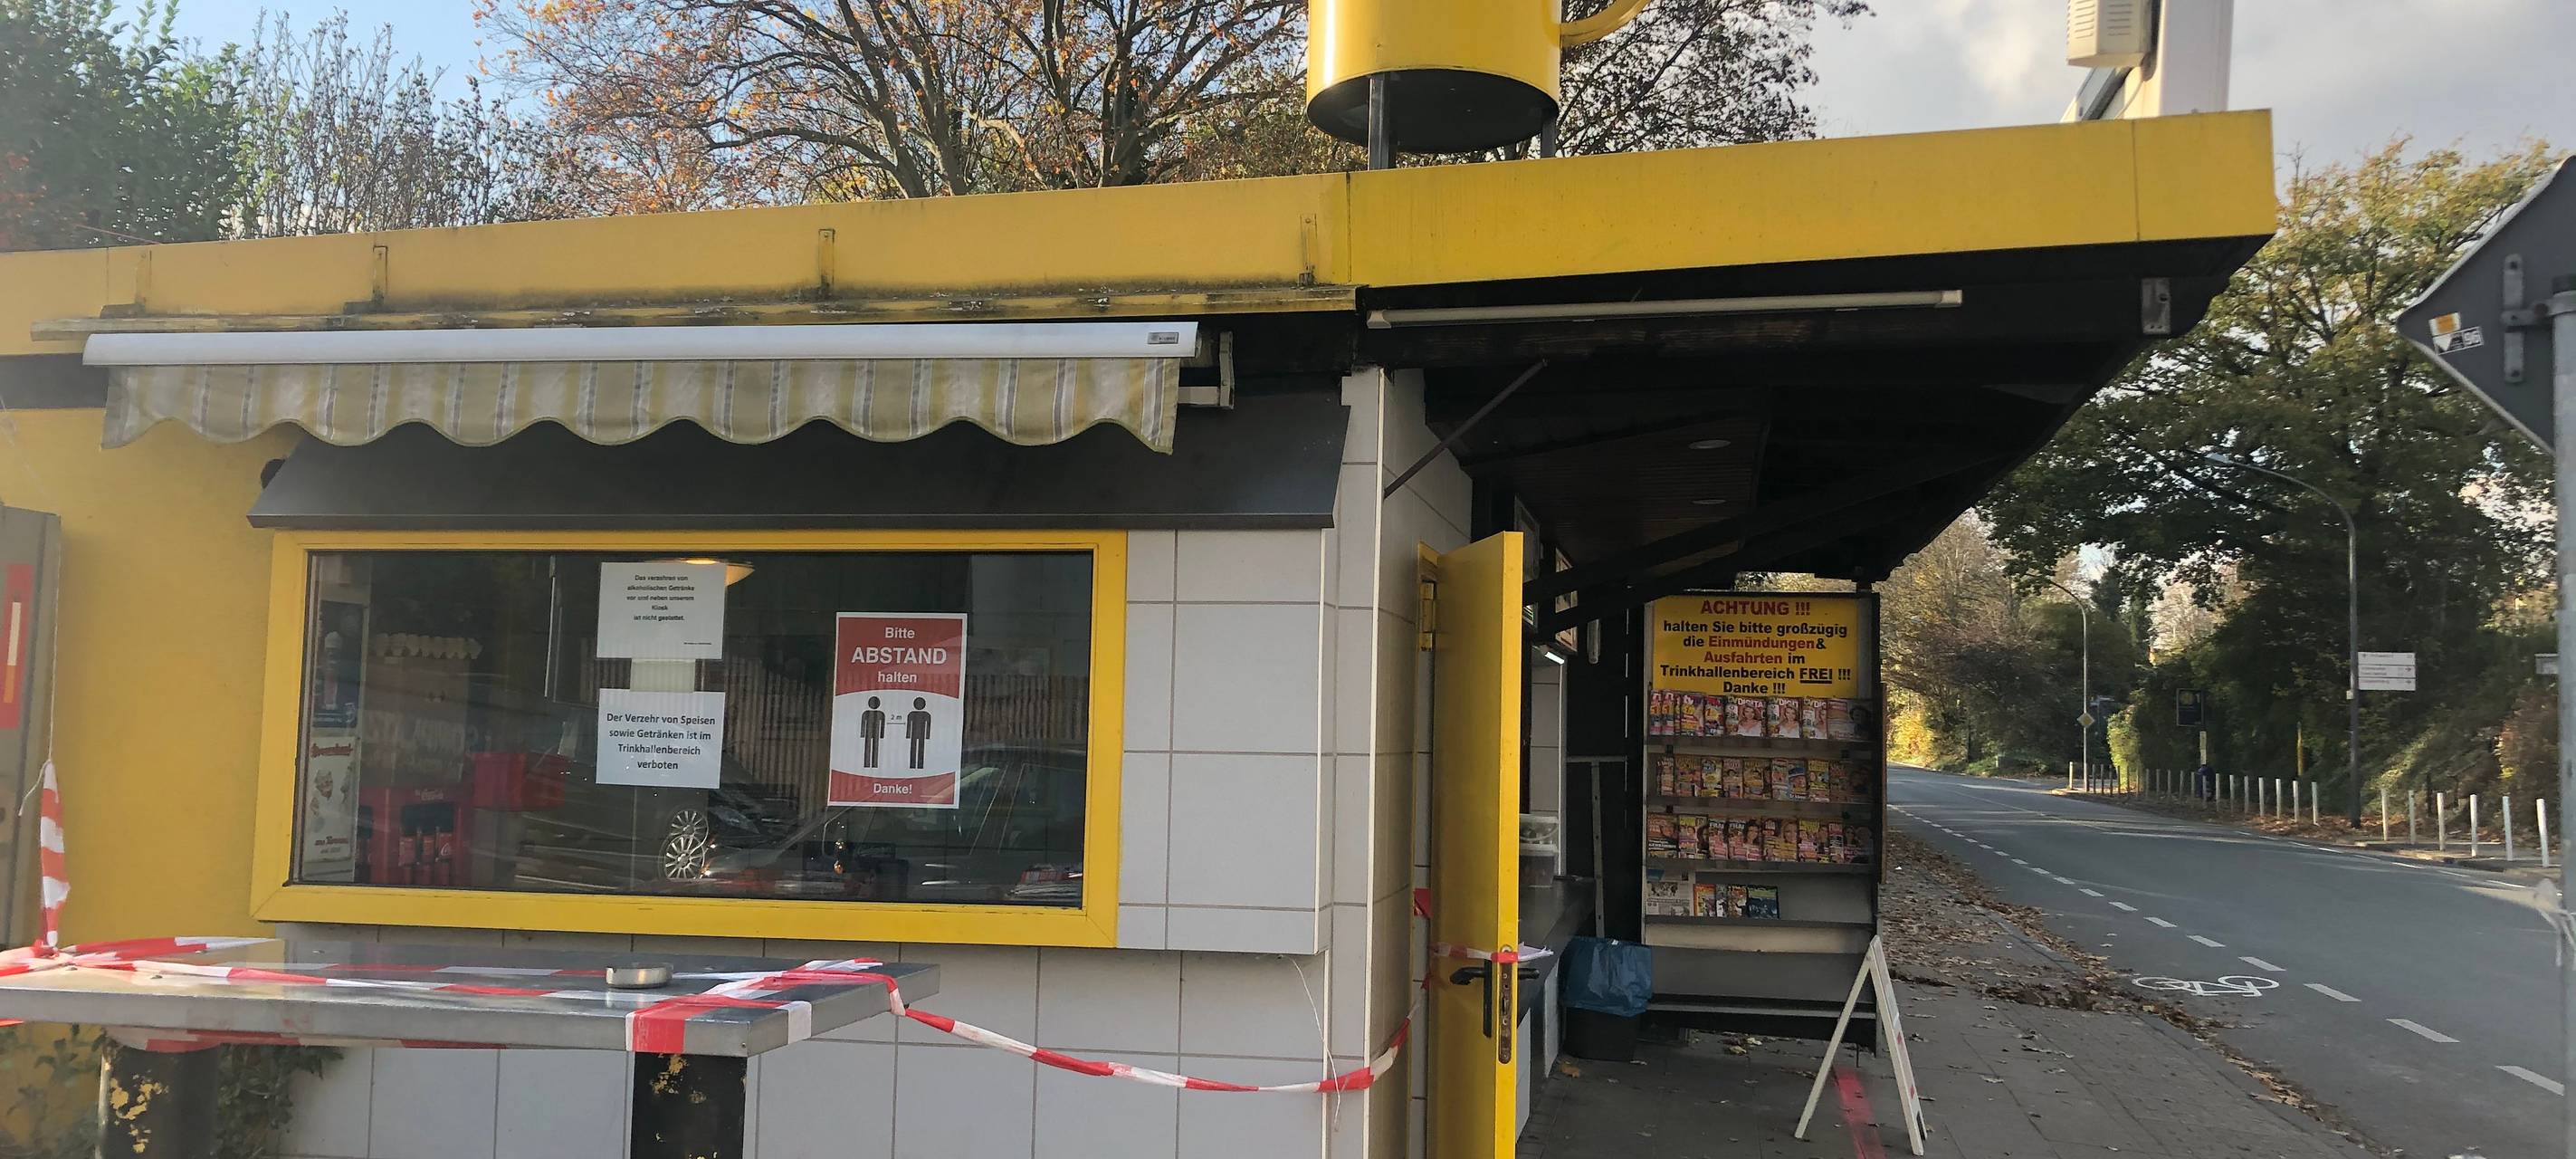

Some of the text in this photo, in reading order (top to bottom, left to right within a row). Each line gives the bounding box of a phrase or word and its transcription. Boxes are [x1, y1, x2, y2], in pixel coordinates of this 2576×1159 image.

[1701, 599, 1810, 616] ACHTUNG !!!
[884, 627, 915, 639] Bitte
[1663, 620, 1847, 637] halten Sie bitte großzügig
[1683, 635, 1704, 647] die
[851, 647, 947, 665] ABSTAND
[1703, 651, 1806, 665] Ausfahrten im
[877, 671, 918, 684] halten
[1660, 664, 1851, 681] Trinkhallenbereich FREI !!!
[1722, 681, 1786, 694] Danke !!!
[606, 713, 716, 726] Der Verzehr von Speisen
[609, 729, 711, 741] sowie Getränken ist im
[617, 743, 701, 755] Trinkhallenbereich
[637, 760, 679, 770] verboten
[873, 783, 913, 795] Danke!
